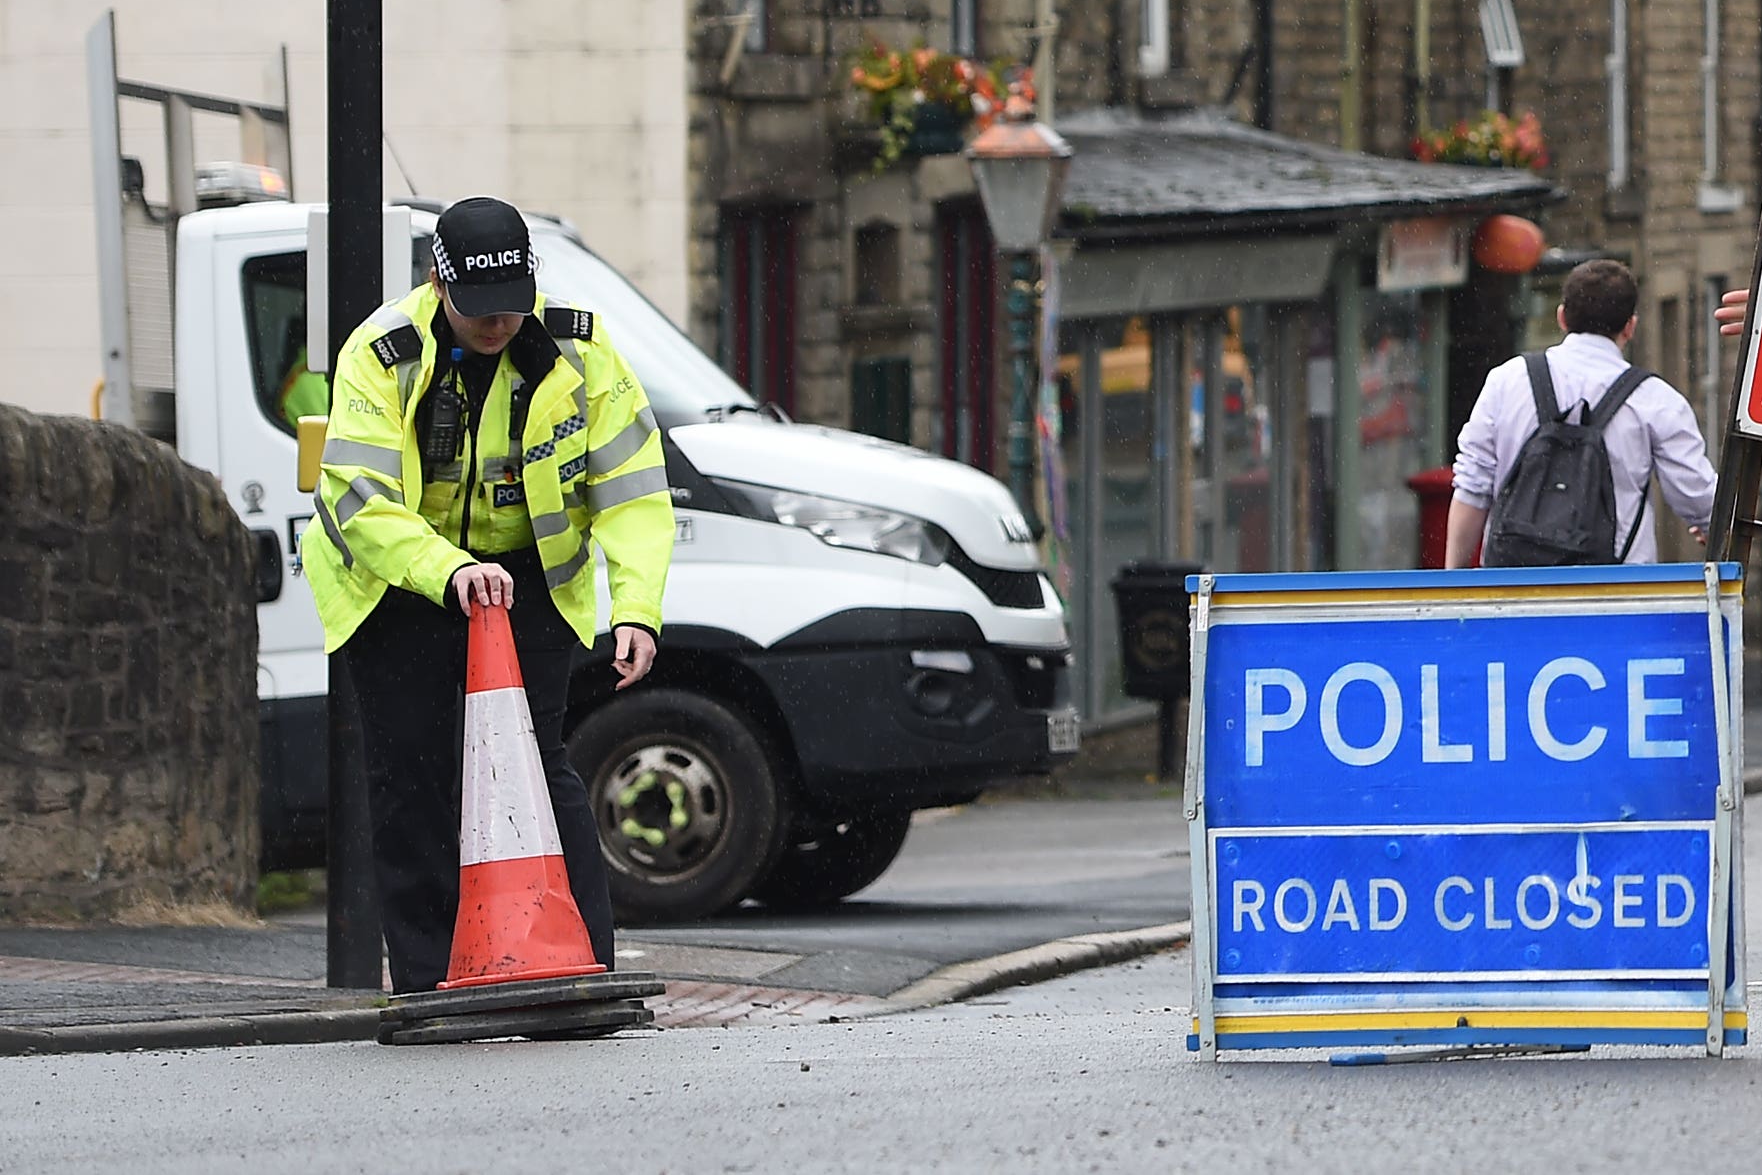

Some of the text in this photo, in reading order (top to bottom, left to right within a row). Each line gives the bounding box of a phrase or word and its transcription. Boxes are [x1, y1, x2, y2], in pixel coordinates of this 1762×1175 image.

[465, 249, 522, 271] POLICE
[1243, 656, 1690, 768] POLICE
[1232, 874, 1696, 933] ROAD CLOSED
